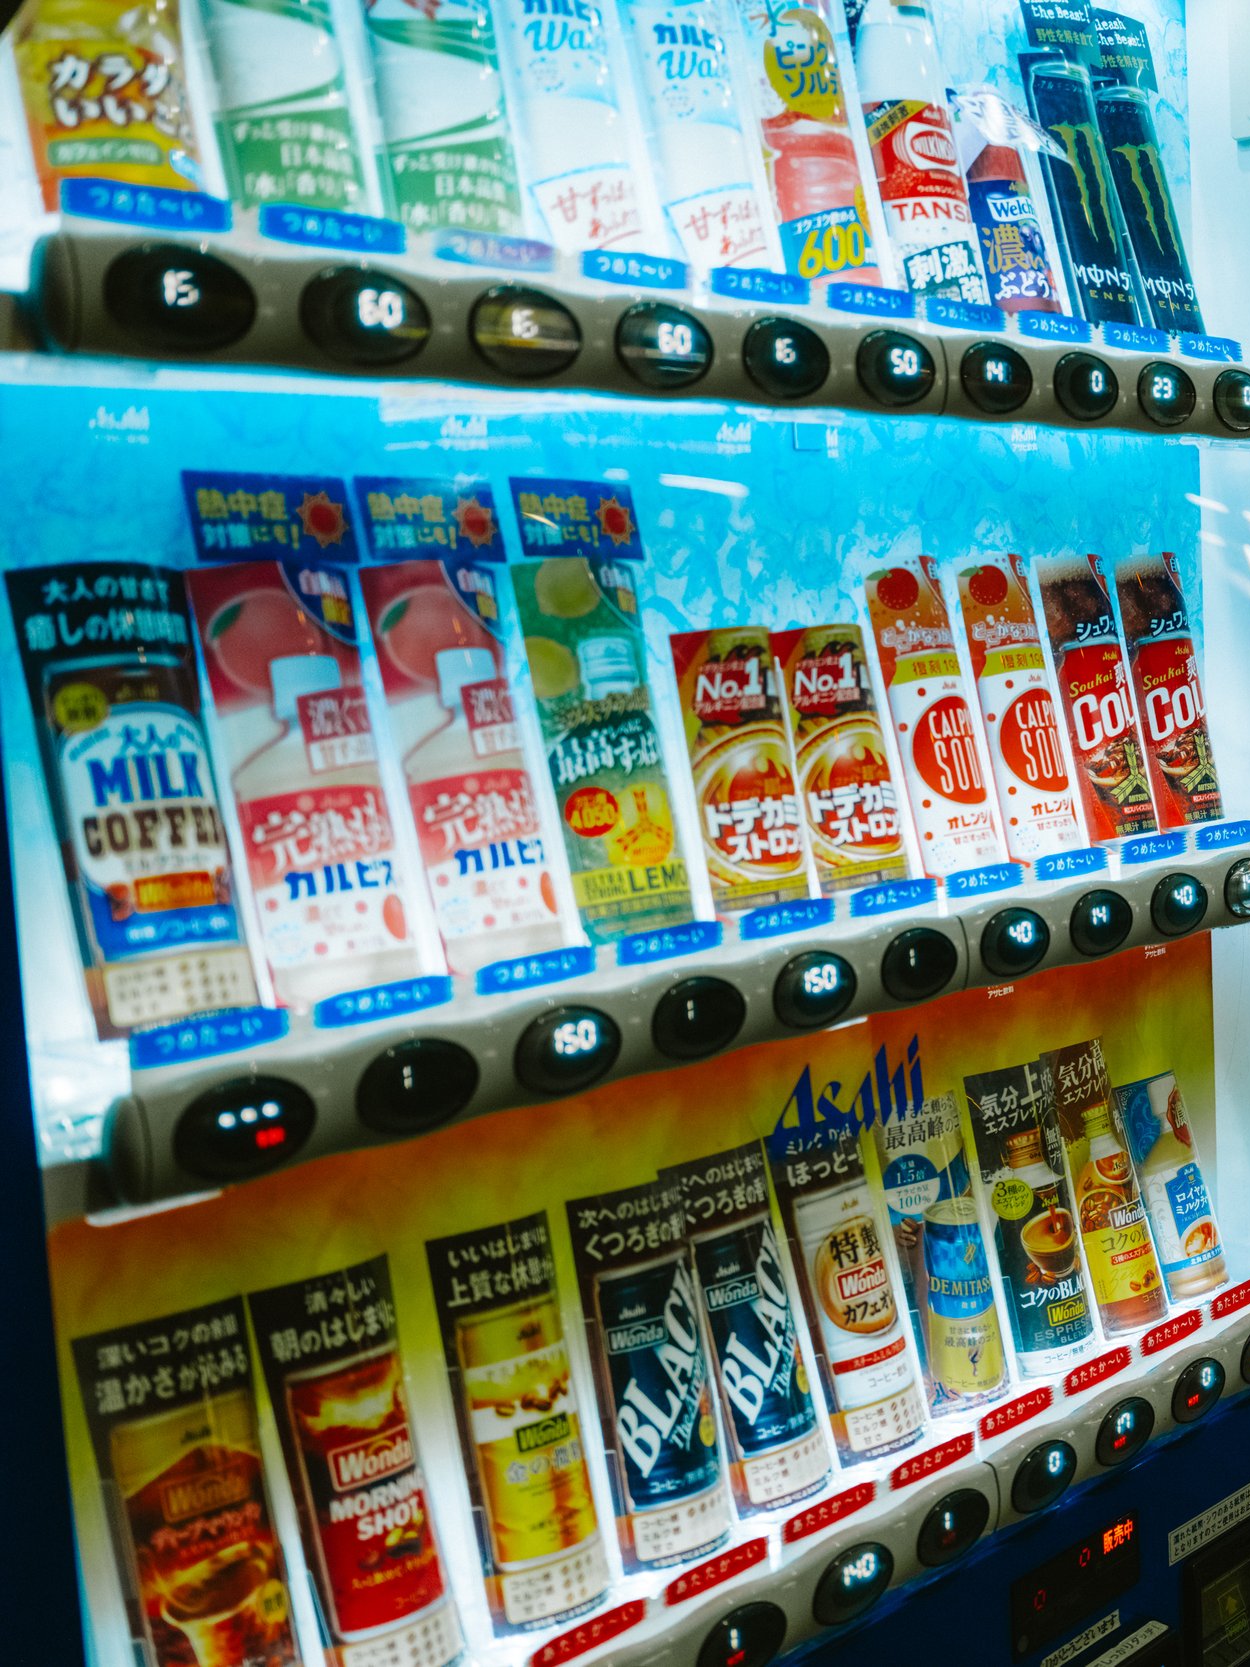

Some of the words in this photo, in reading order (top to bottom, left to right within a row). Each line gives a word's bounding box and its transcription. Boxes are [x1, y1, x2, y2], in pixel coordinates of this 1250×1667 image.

[994, 271, 1049, 301] ぶどう
[1090, 372, 1103, 393] 0
[1152, 377, 1174, 399] 23
[698, 657, 763, 699] No.1
[794, 652, 857, 696] No.1
[87, 752, 203, 806] MILK
[767, 1033, 925, 1156] Asahi
[995, 1181, 1026, 1198] 3種の
[830, 1216, 881, 1268] 特製
[708, 1280, 760, 1307] Wonda
[841, 1263, 887, 1299] Wonda
[1051, 1300, 1085, 1320] Wonda
[609, 1323, 664, 1351] Wonda
[1201, 1366, 1212, 1388] 0
[1048, 1451, 1061, 1474] 0
[355, 1499, 422, 1541] SHOT
[1102, 1519, 1134, 1555] 販売中
